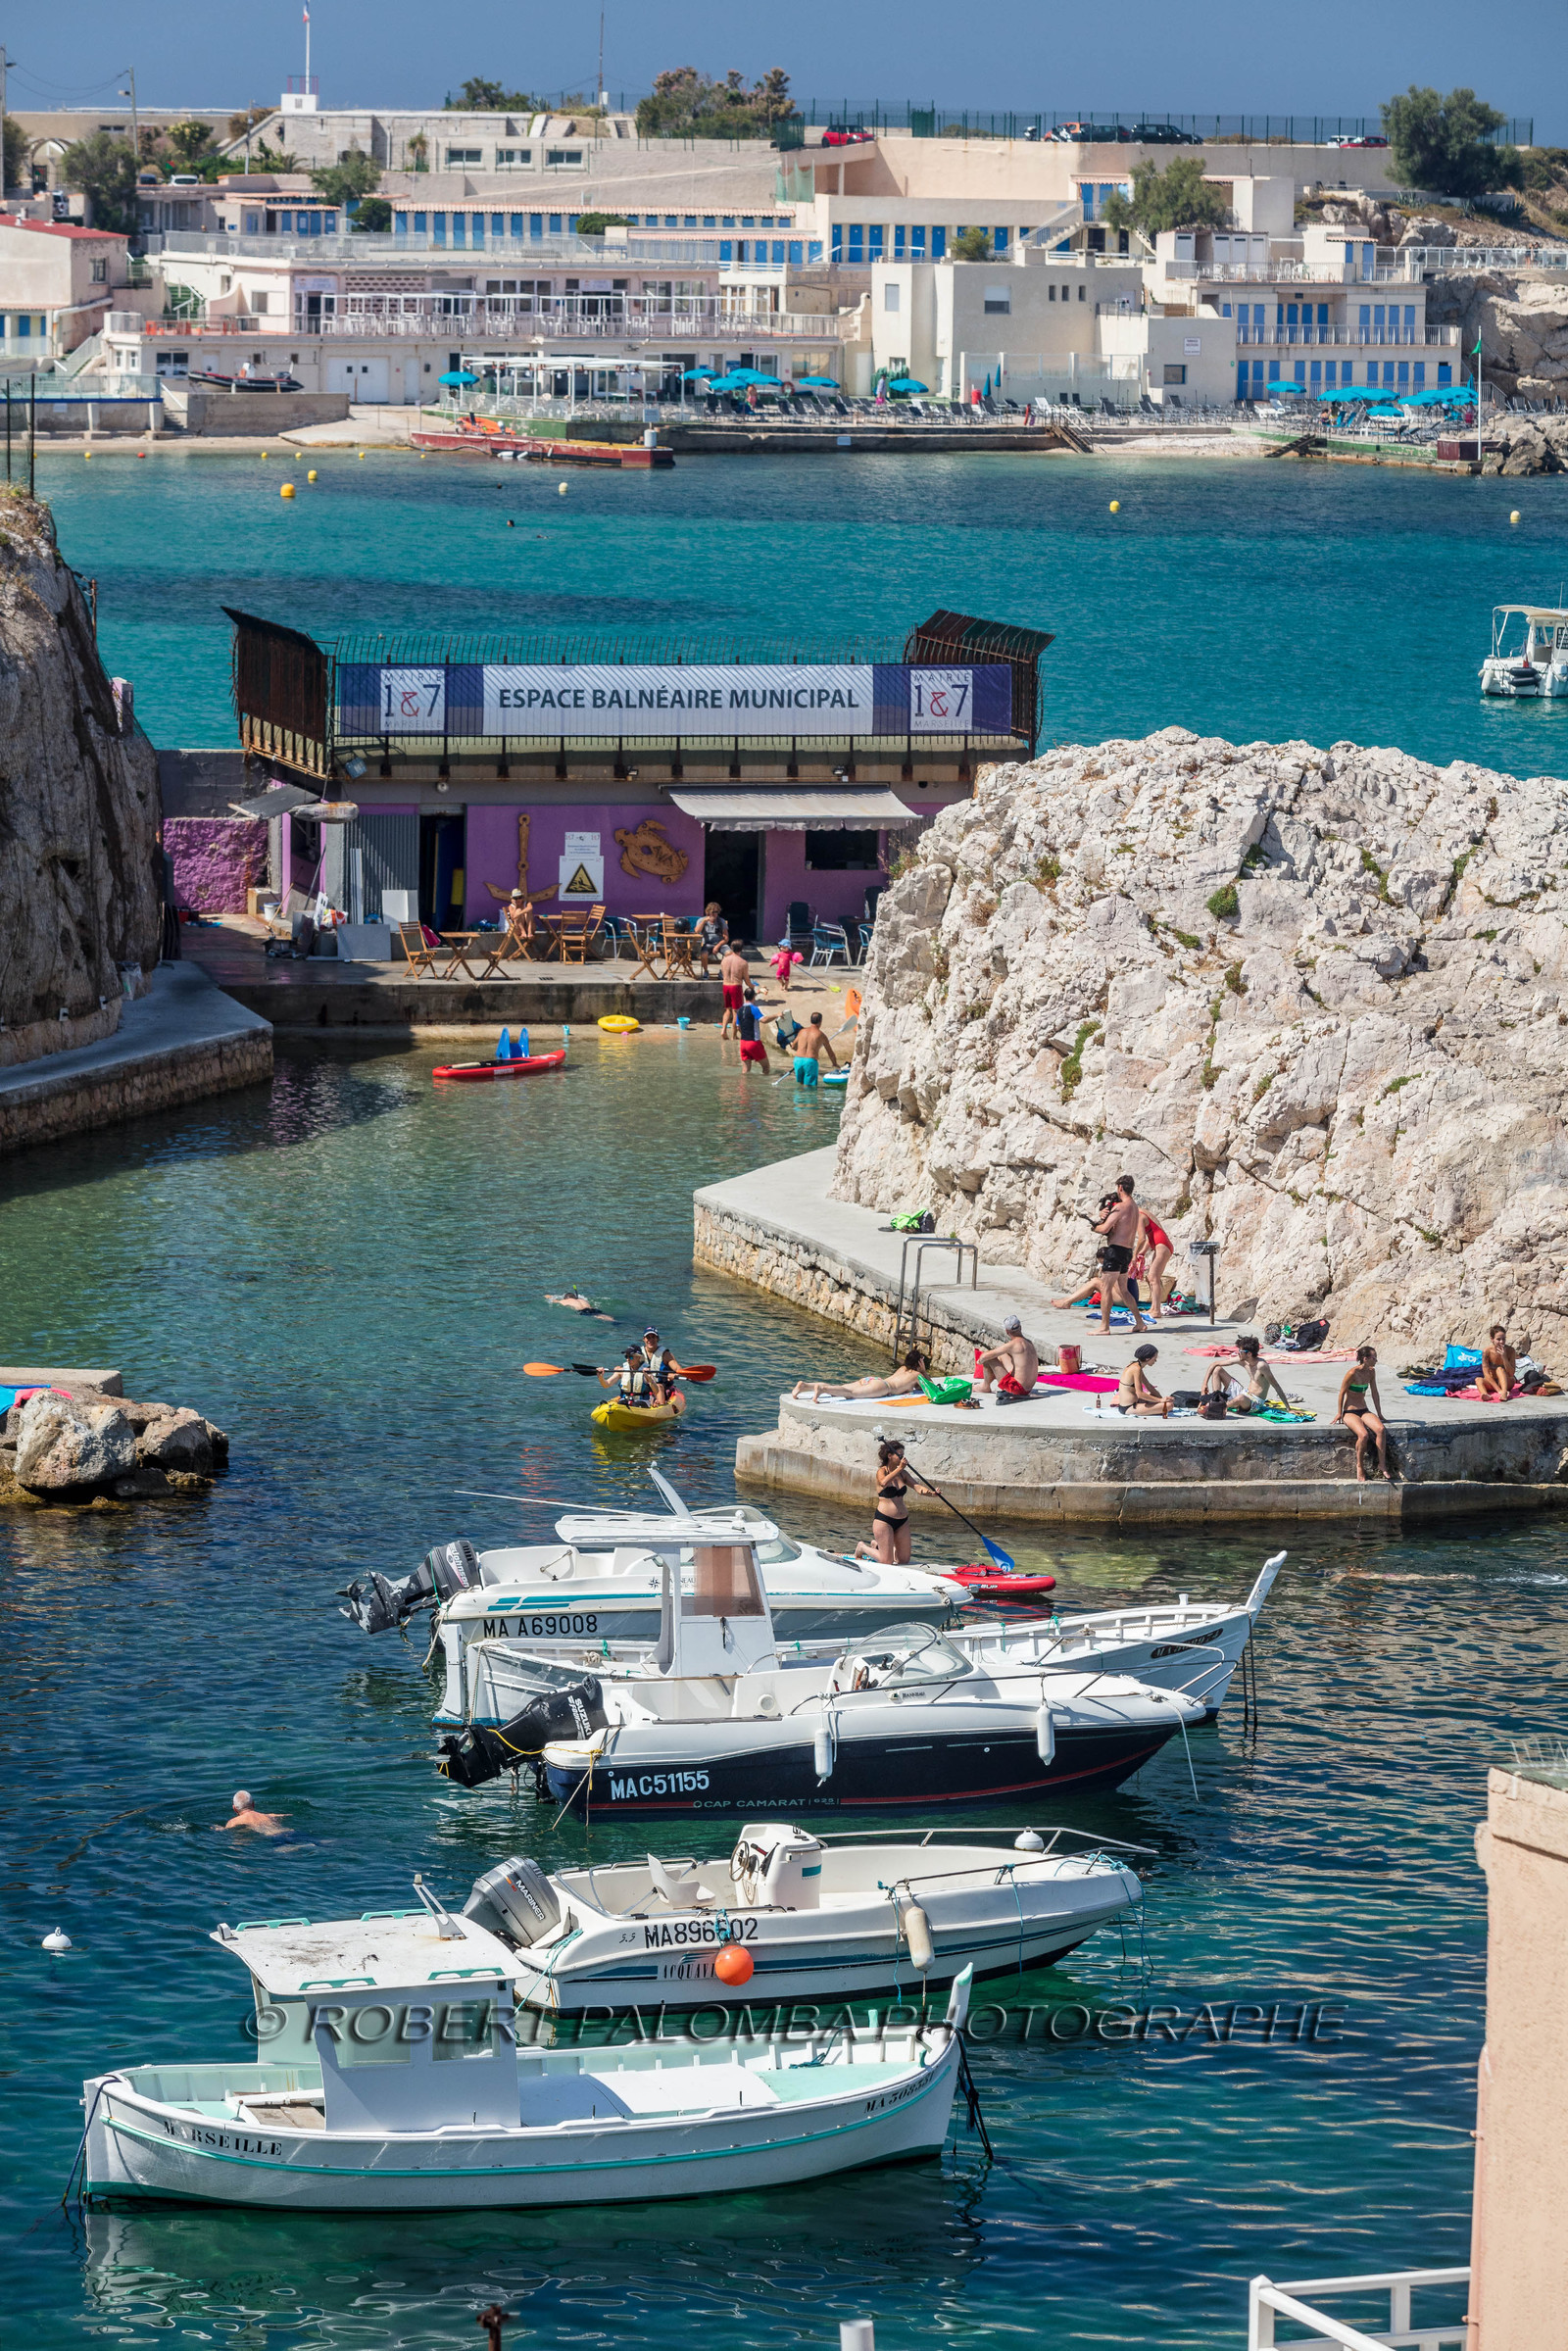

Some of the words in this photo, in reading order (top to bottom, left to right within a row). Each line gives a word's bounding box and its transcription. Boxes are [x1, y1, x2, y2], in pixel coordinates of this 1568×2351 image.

[384, 672, 442, 682] MAIRIE
[913, 672, 970, 682] MAIRIE
[499, 688, 585, 709] ESPACE
[591, 684, 722, 709] BALNÉAIRE
[729, 689, 859, 709] MUNICIPAL
[384, 719, 442, 729] MARSEILLE
[913, 719, 970, 729] MARSEILLE
[483, 1618, 510, 1639] MA
[517, 1614, 598, 1637] A69008
[574, 1697, 593, 1737] SUZUKI
[704, 1799, 731, 1808] CAP
[736, 1798, 807, 1807] CAMARAT
[515, 1879, 546, 1921] MARINER
